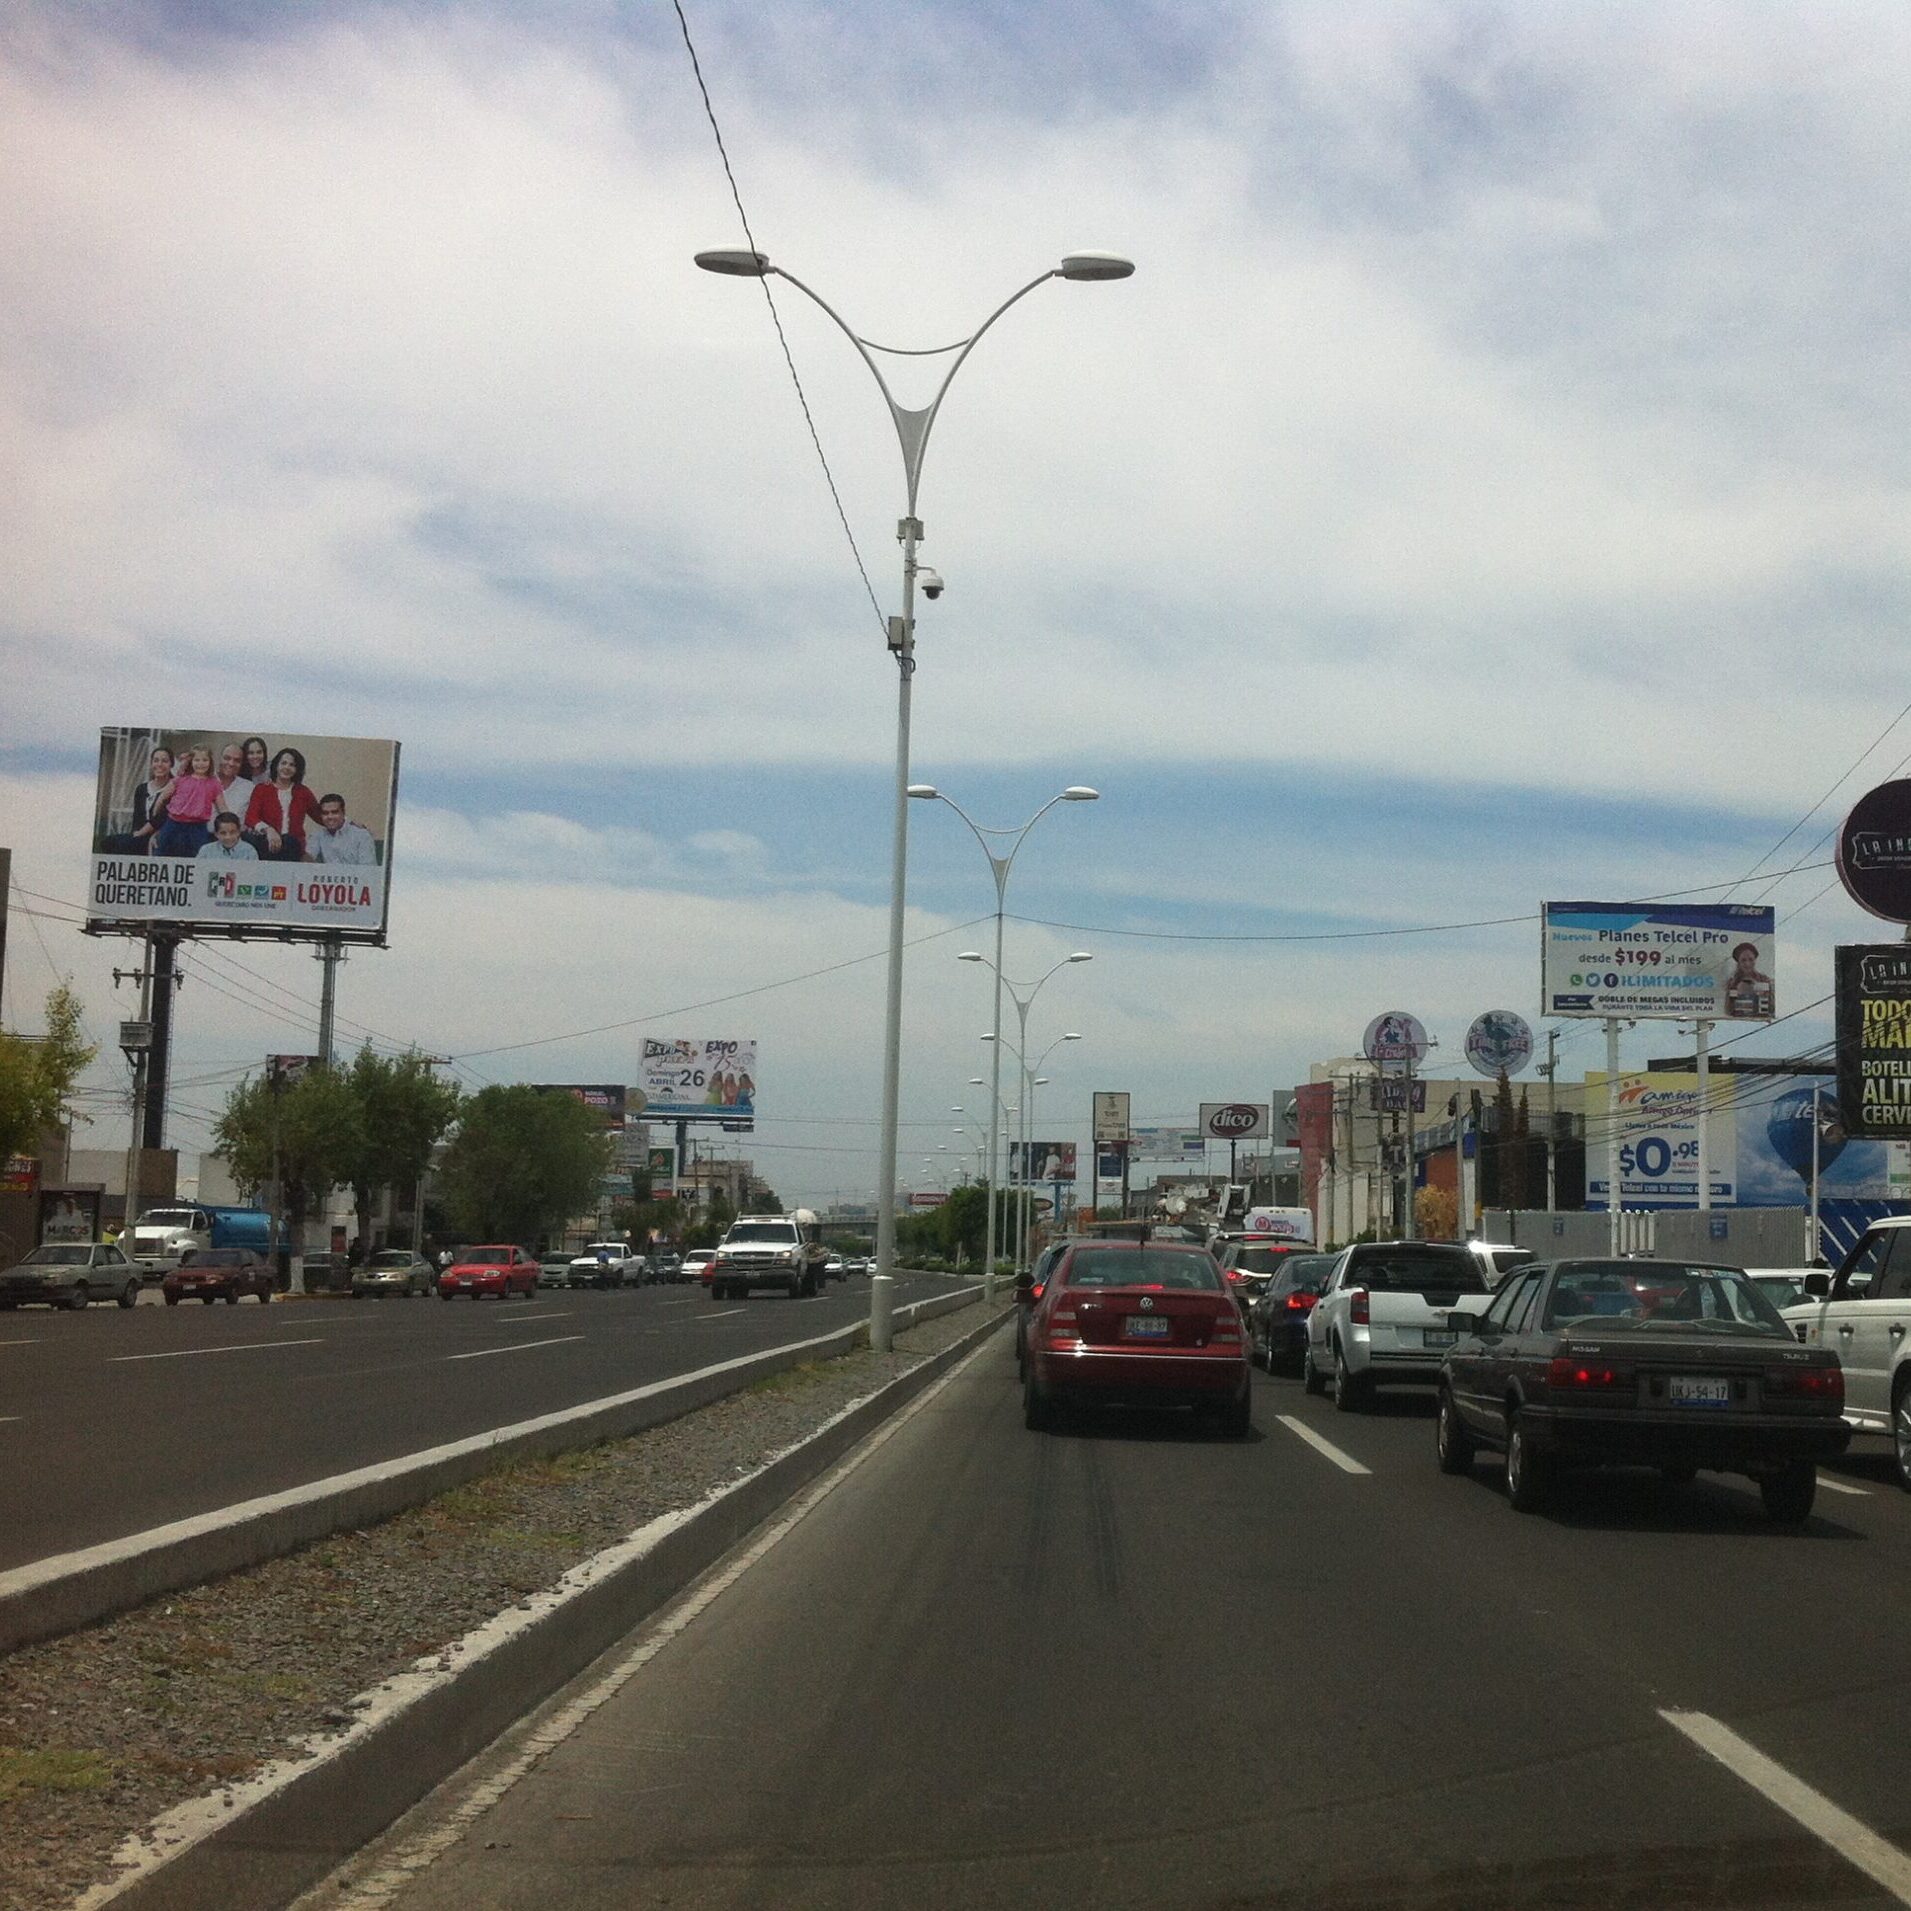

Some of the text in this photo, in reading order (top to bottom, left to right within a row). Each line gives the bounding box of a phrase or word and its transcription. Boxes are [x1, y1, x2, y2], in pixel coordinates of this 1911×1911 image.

[97, 861, 196, 885] PALABRA DE
[95, 883, 193, 907] QUERETANO.
[297, 883, 372, 906] LOYOLA
[1598, 929, 1650, 943] Planes
[1654, 930, 1698, 944] Telcel
[1702, 930, 1729, 944] Pro
[1578, 947, 1702, 966] desde $199 al mes
[1598, 995, 1626, 1003] DOBLE
[1640, 996, 1669, 1004] MEGAS
[1671, 996, 1716, 1005] INCLUIDOS
[705, 1040, 738, 1054] EXPO
[648, 1069, 705, 1087] ABRIL 26
[1213, 1109, 1256, 1128] dico
